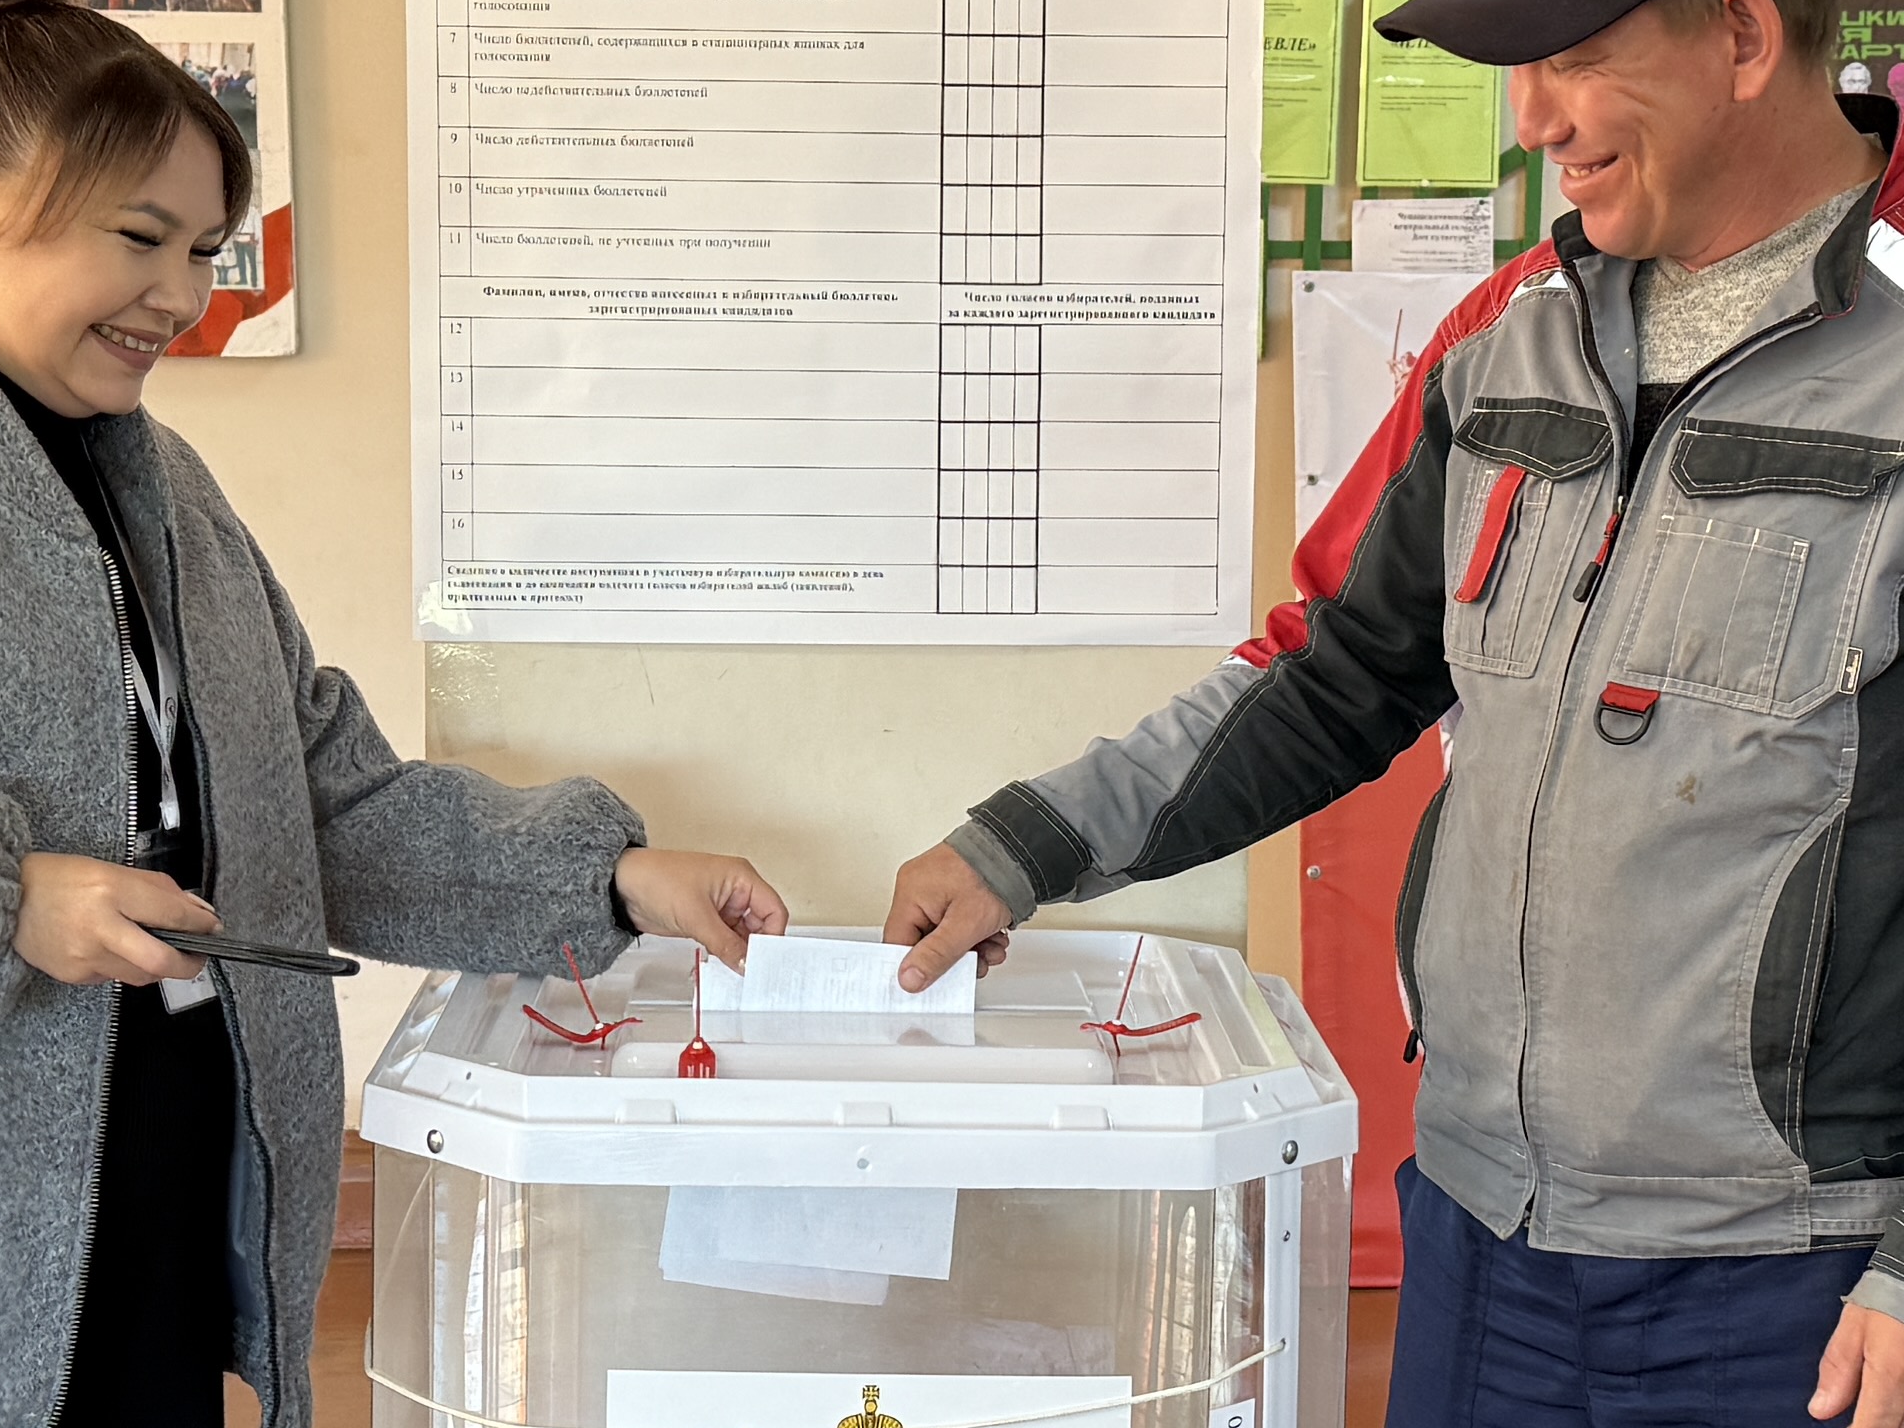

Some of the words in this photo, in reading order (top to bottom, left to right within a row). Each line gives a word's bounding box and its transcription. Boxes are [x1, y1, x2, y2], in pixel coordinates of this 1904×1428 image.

[450, 32, 456, 42] 7
[475, 32, 511, 45] Число
[451, 83, 456, 93] 8
[475, 82, 512, 95] Число
[451, 133, 457, 143] 9
[475, 132, 512, 145] Число
[450, 183, 462, 193] 10
[476, 182, 513, 195] Число
[450, 232, 460, 244] 11
[476, 232, 513, 244] Число
[451, 323, 462, 334] 12
[451, 372, 462, 382] 13
[452, 421, 463, 432] 14
[452, 469, 463, 480] 15
[453, 518, 464, 529] 16
